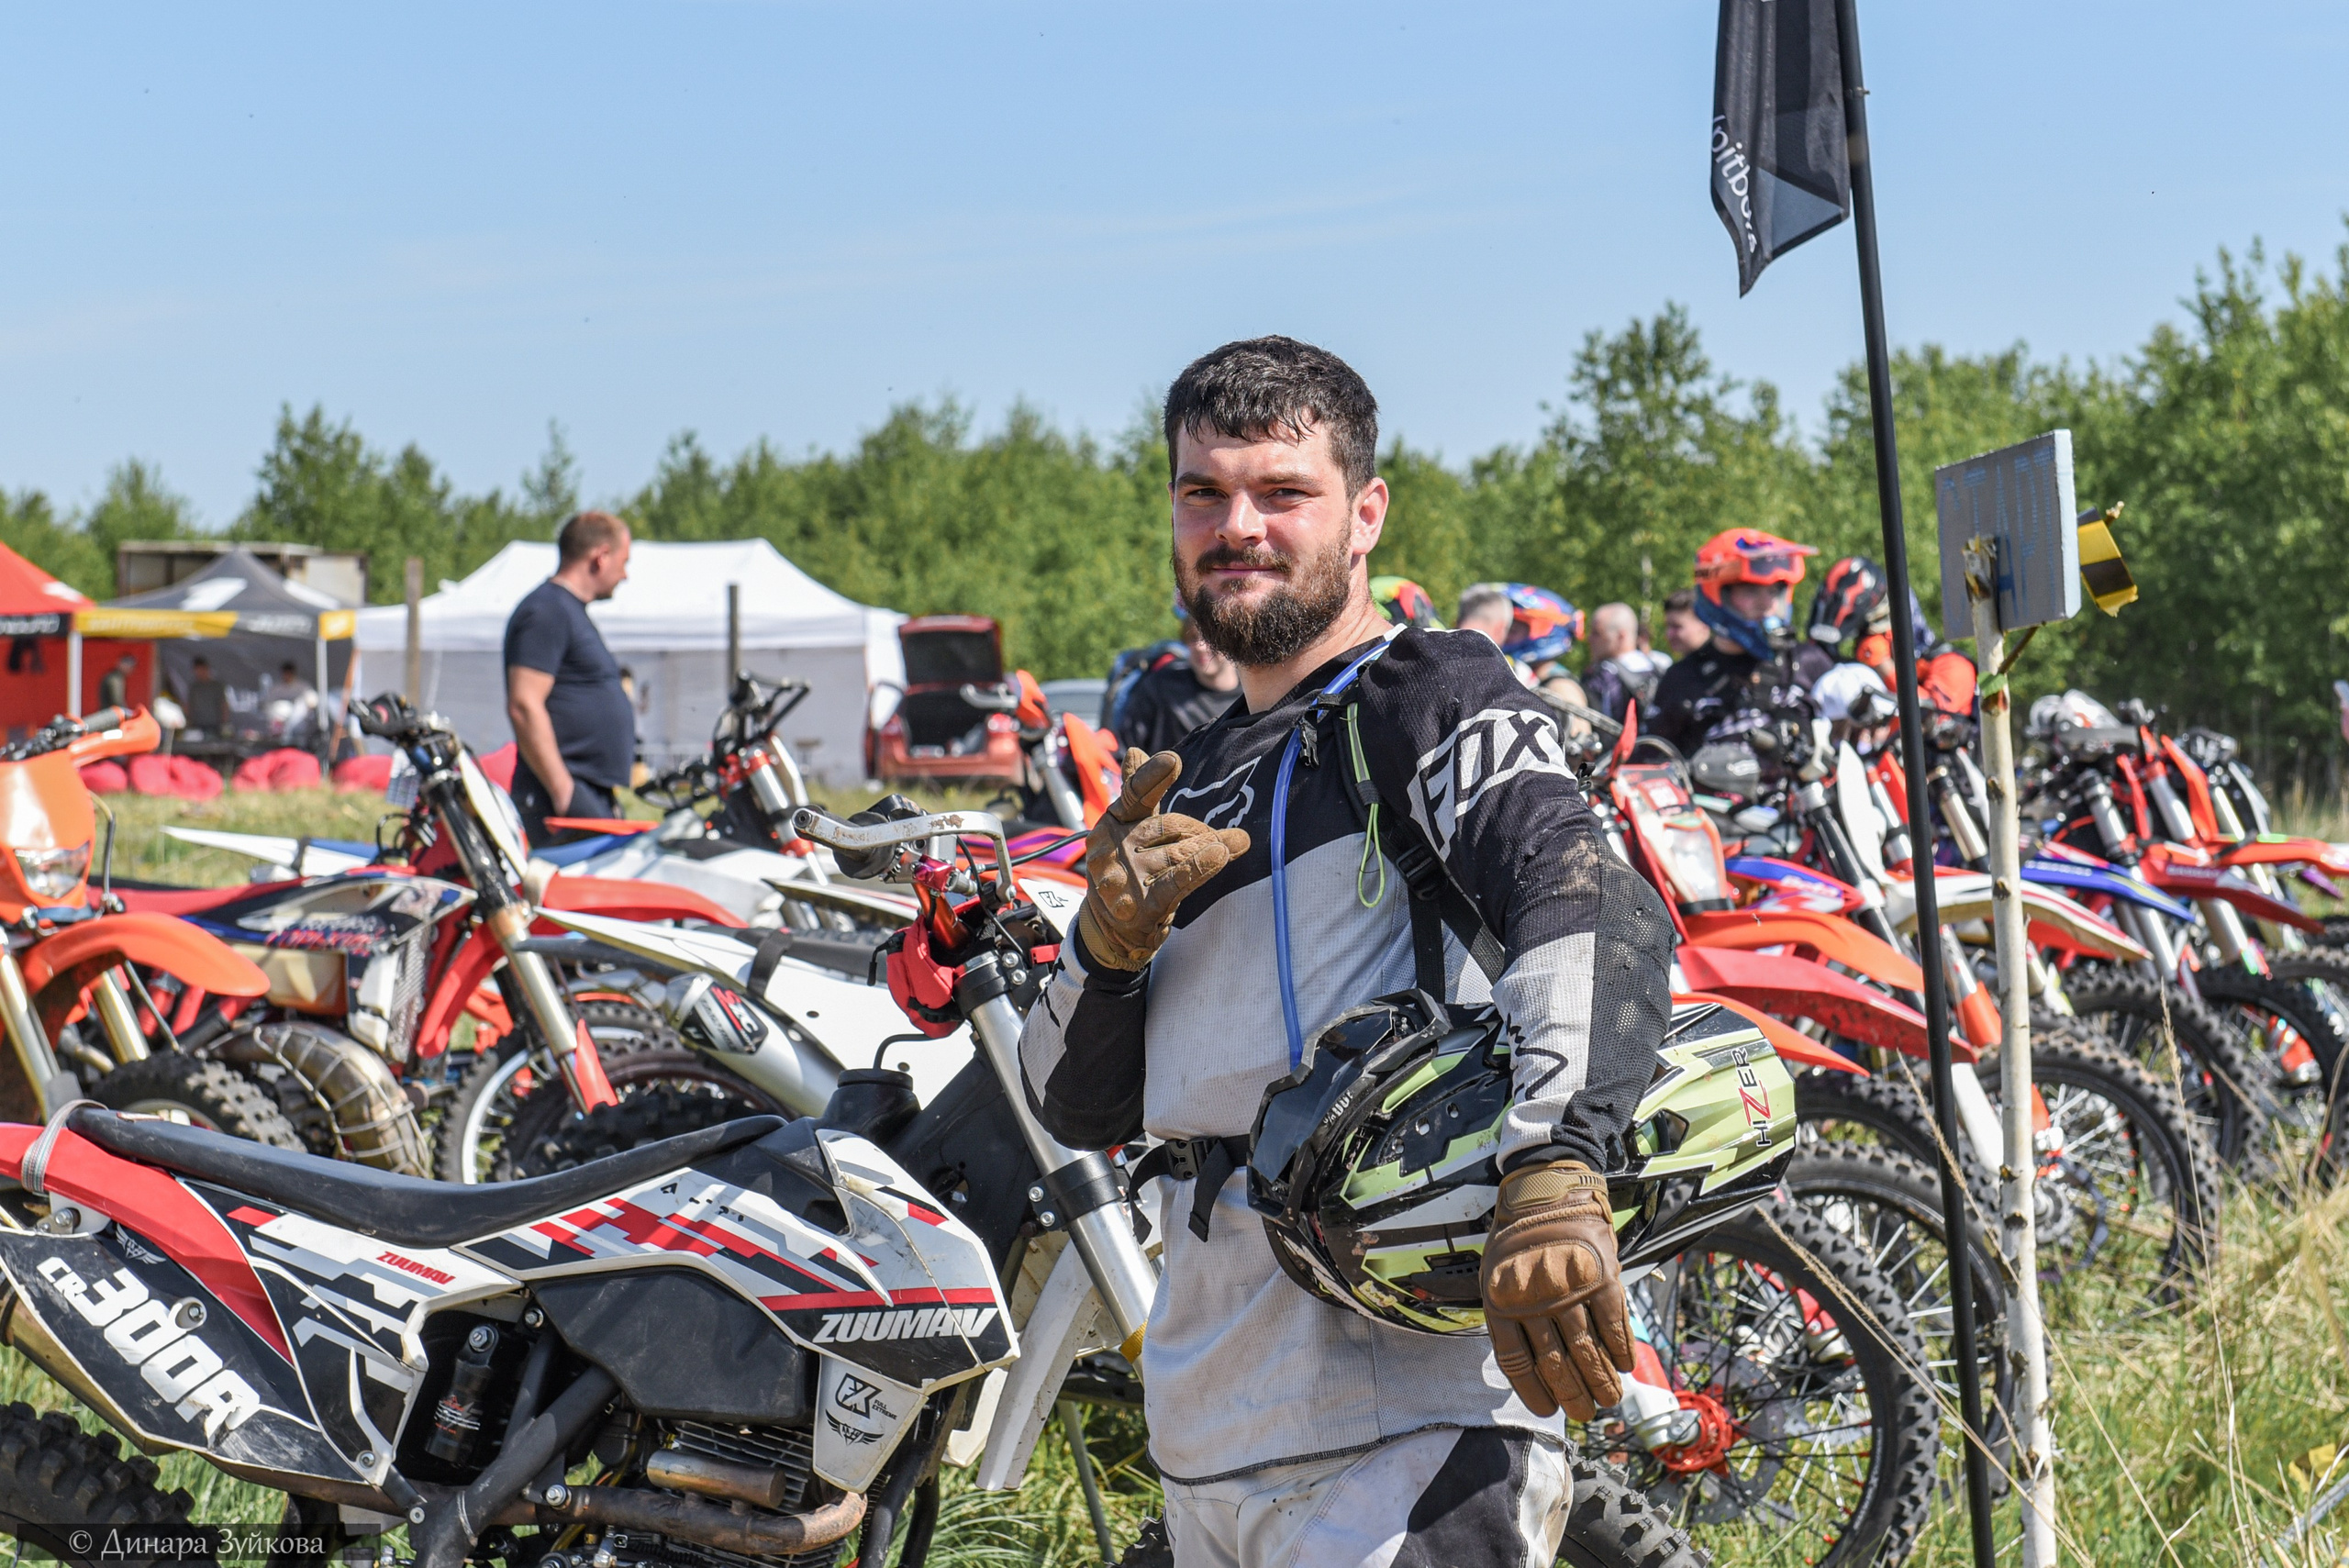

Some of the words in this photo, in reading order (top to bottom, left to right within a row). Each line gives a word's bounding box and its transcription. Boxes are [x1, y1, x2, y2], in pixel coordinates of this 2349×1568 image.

[1413, 710, 1558, 854] FOX
[1731, 1047, 1772, 1147] HIZER
[872, 1404, 897, 1420] EXTREME
[874, 1398, 887, 1410] FULL
